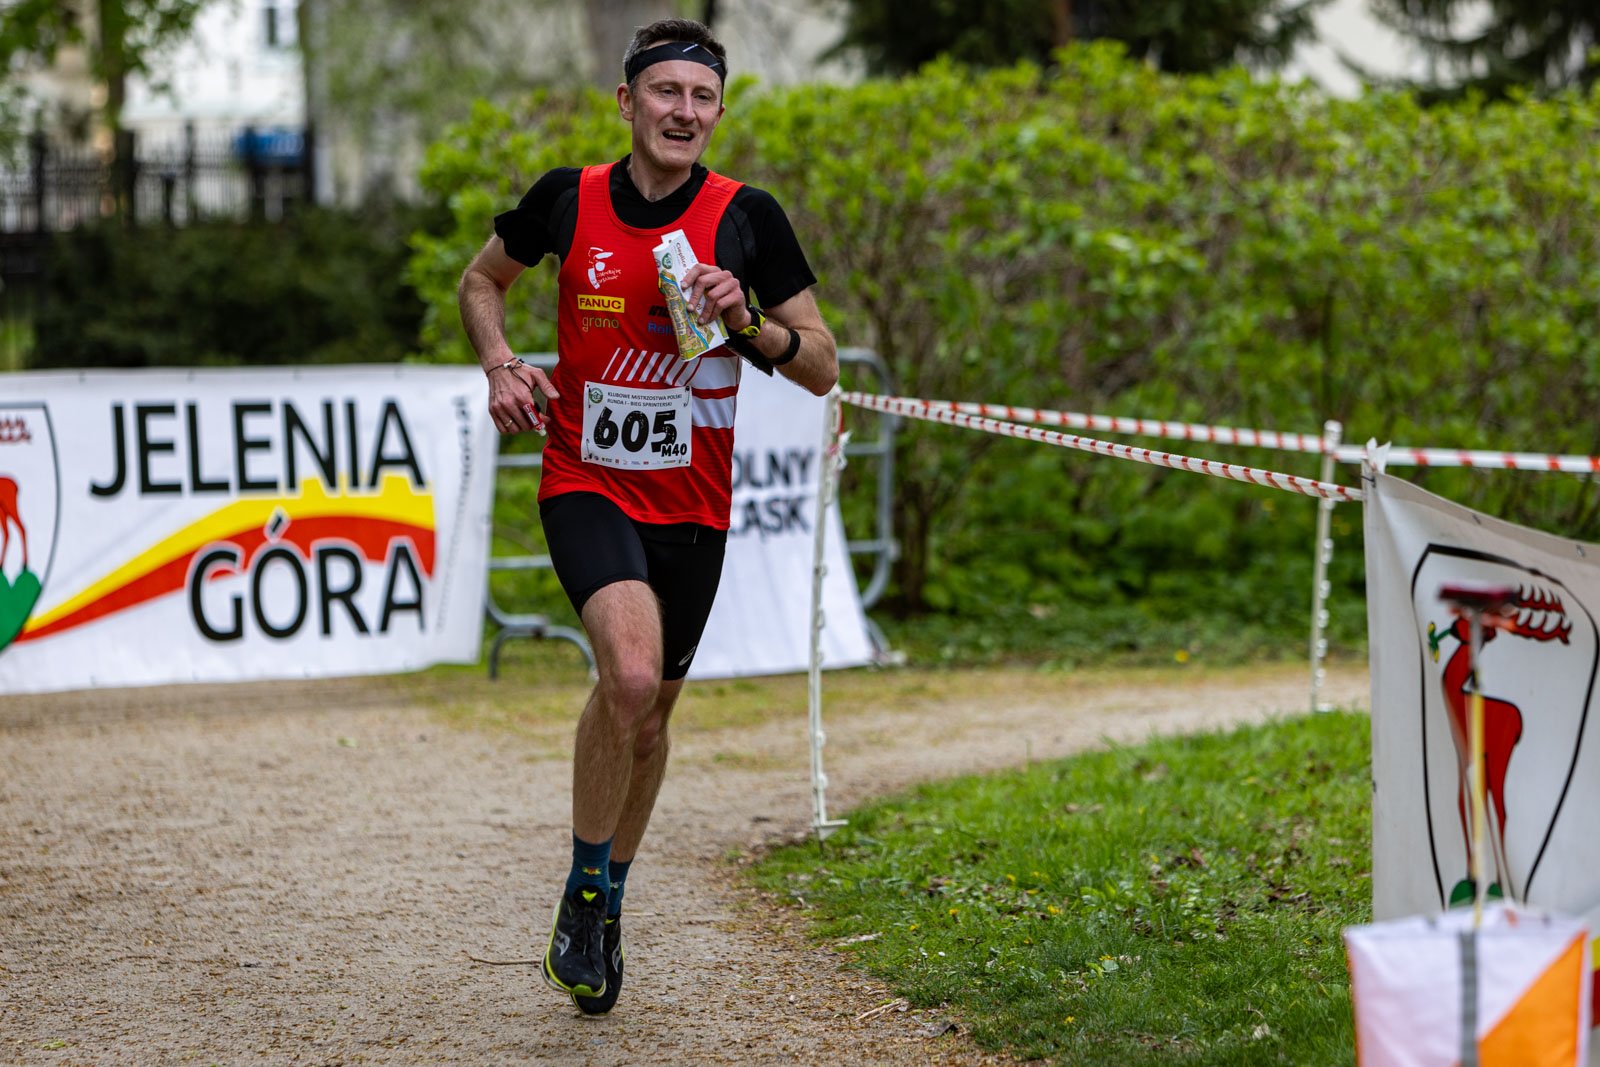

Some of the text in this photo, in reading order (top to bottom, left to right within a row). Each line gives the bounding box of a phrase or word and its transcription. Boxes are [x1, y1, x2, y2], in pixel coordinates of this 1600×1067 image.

[579, 297, 622, 310] FANUC
[582, 316, 619, 332] grano
[607, 391, 630, 399] KLUBOWE
[593, 406, 677, 453] 605
[89, 398, 427, 496] JELENIA
[661, 443, 687, 457] M40
[189, 510, 425, 641] GÓRA
